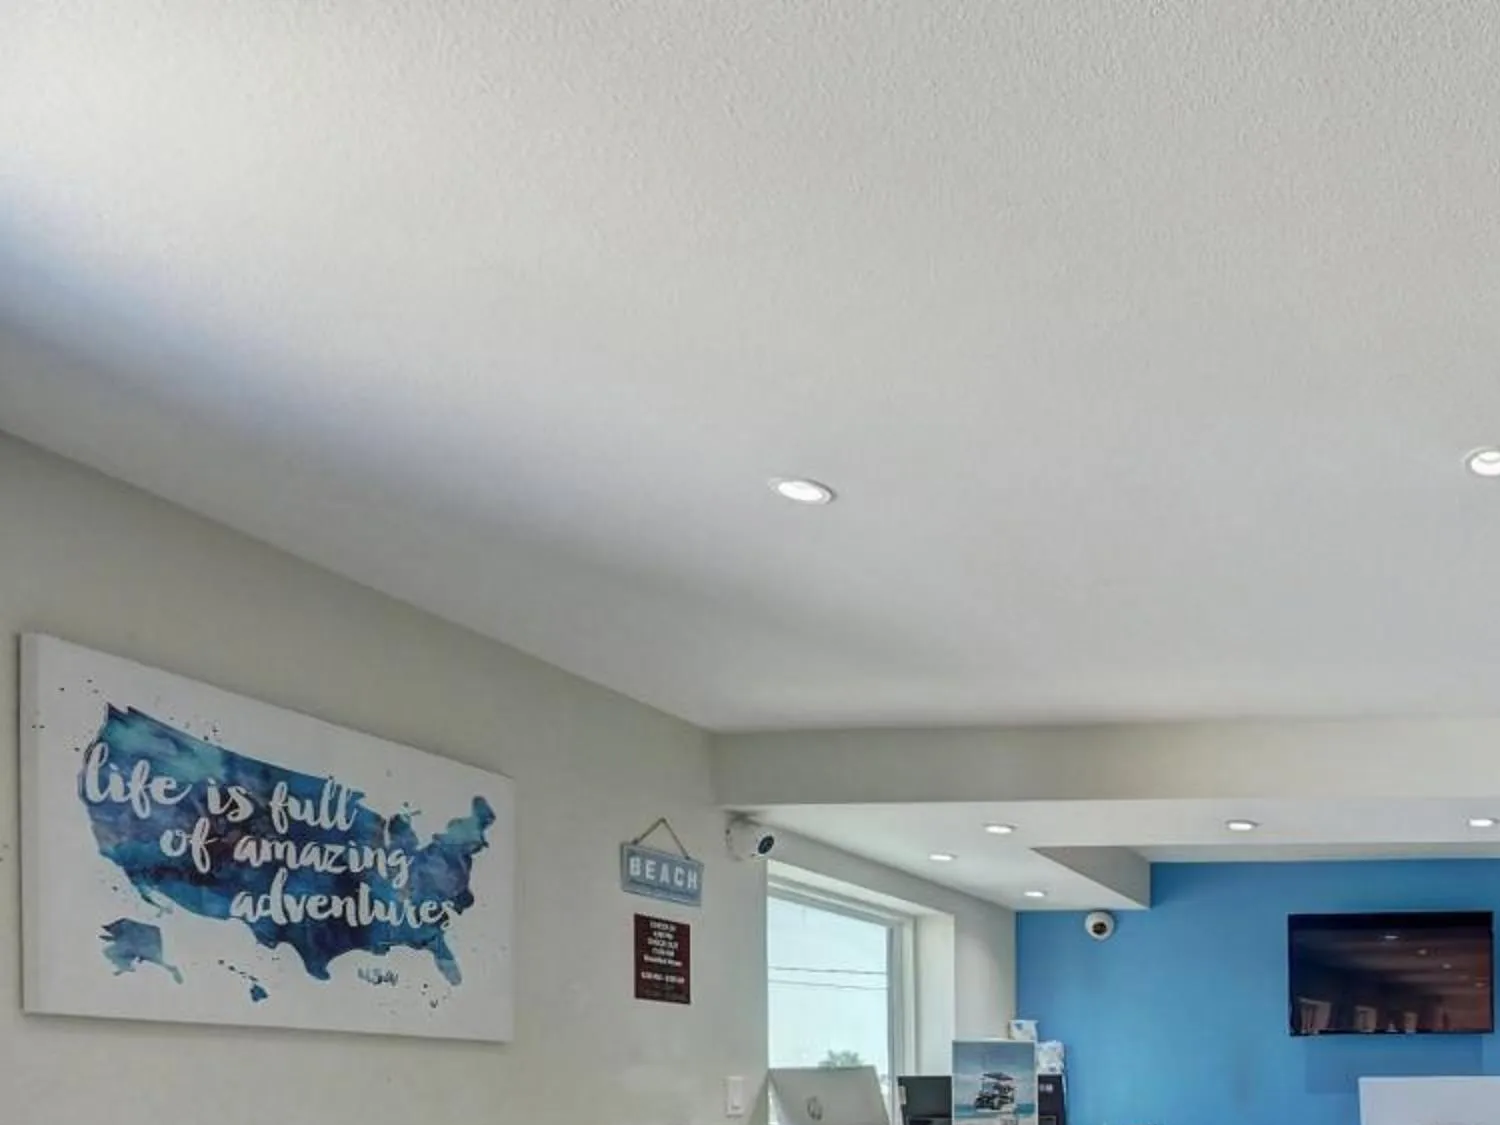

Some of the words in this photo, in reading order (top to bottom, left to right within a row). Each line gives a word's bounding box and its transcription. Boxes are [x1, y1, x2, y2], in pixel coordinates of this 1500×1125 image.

[83, 740, 193, 818] life
[206, 777, 255, 822] is
[270, 780, 363, 832] full
[160, 818, 217, 872] of
[233, 833, 414, 888] amazing
[629, 856, 699, 890] BEACH
[230, 868, 460, 930] adventures
